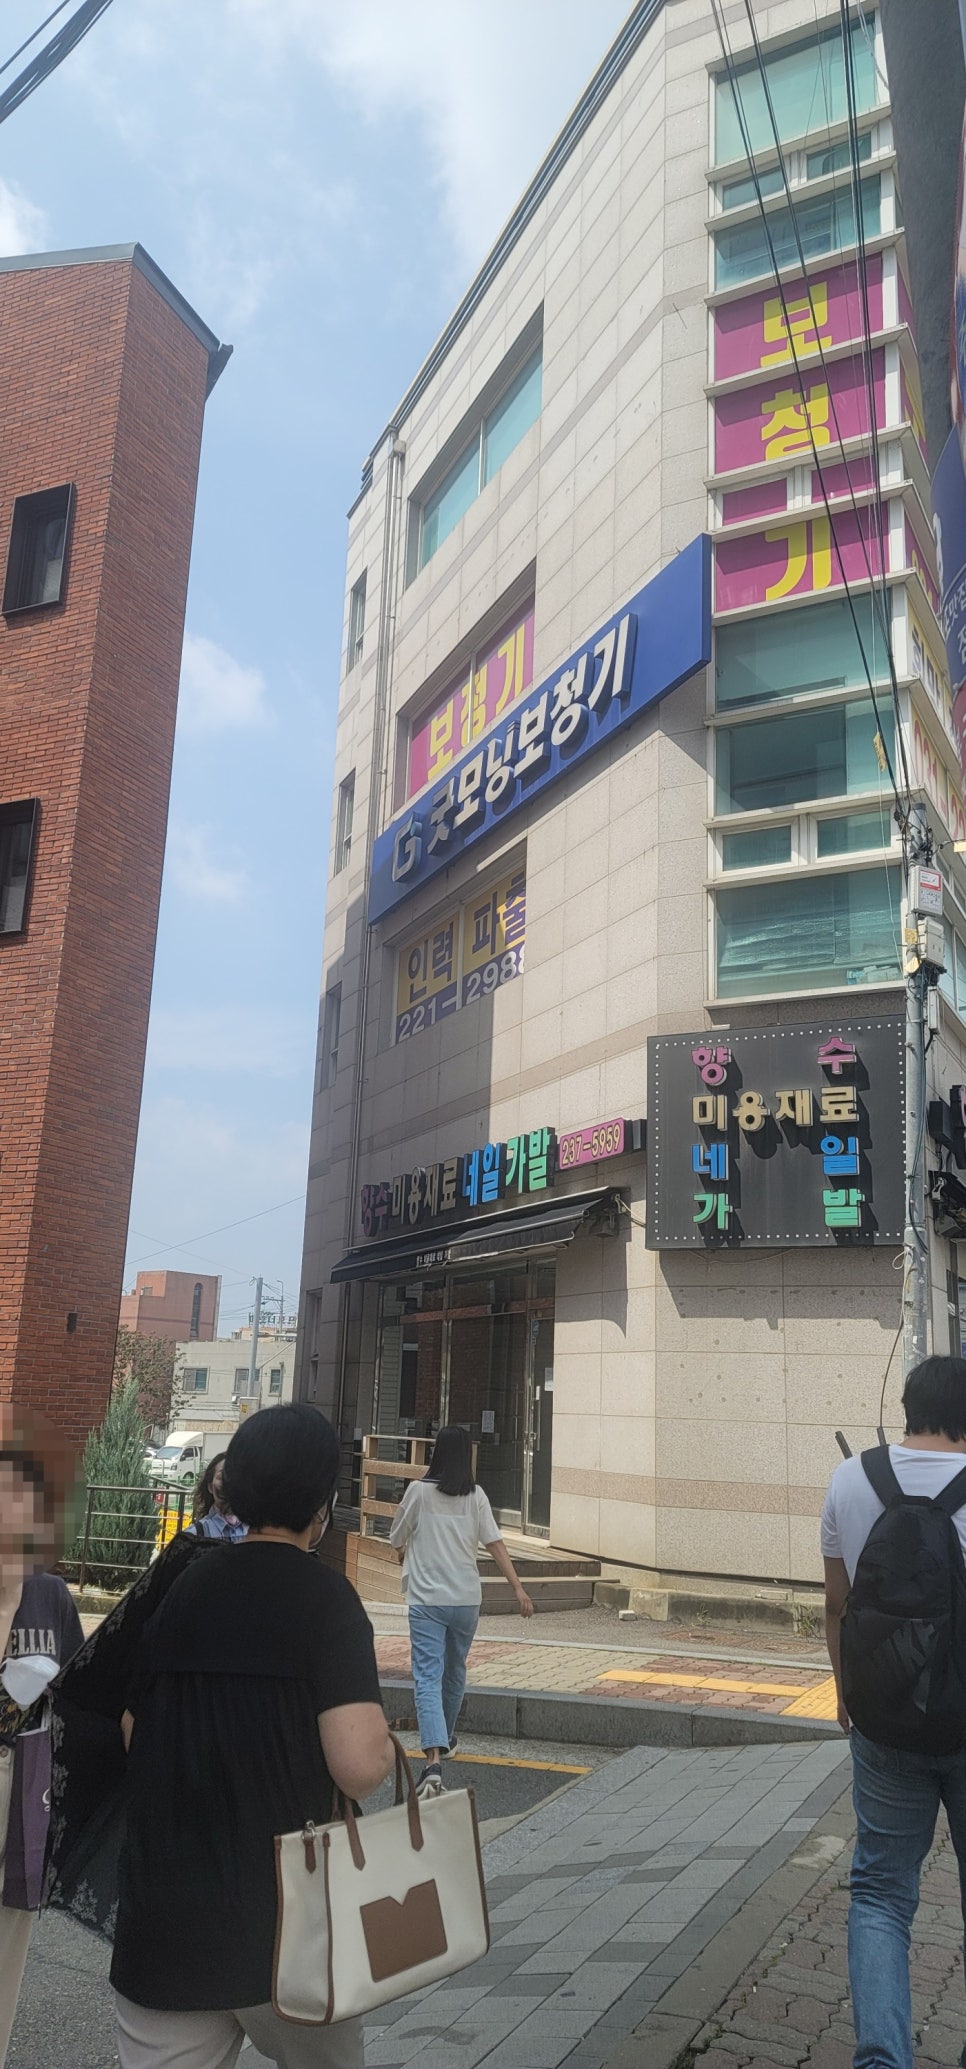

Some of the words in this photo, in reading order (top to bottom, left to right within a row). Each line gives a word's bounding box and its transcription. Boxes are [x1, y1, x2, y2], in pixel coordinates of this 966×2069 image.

[760, 282, 832, 601] 보청기
[427, 612, 634, 855] 굿모닝보청기
[428, 622, 525, 782] 보청기
[408, 921, 454, 1003] 인력
[472, 871, 526, 955] 파출
[562, 1122, 622, 1166] 237-5959
[692, 1086, 860, 1131] 미용재료
